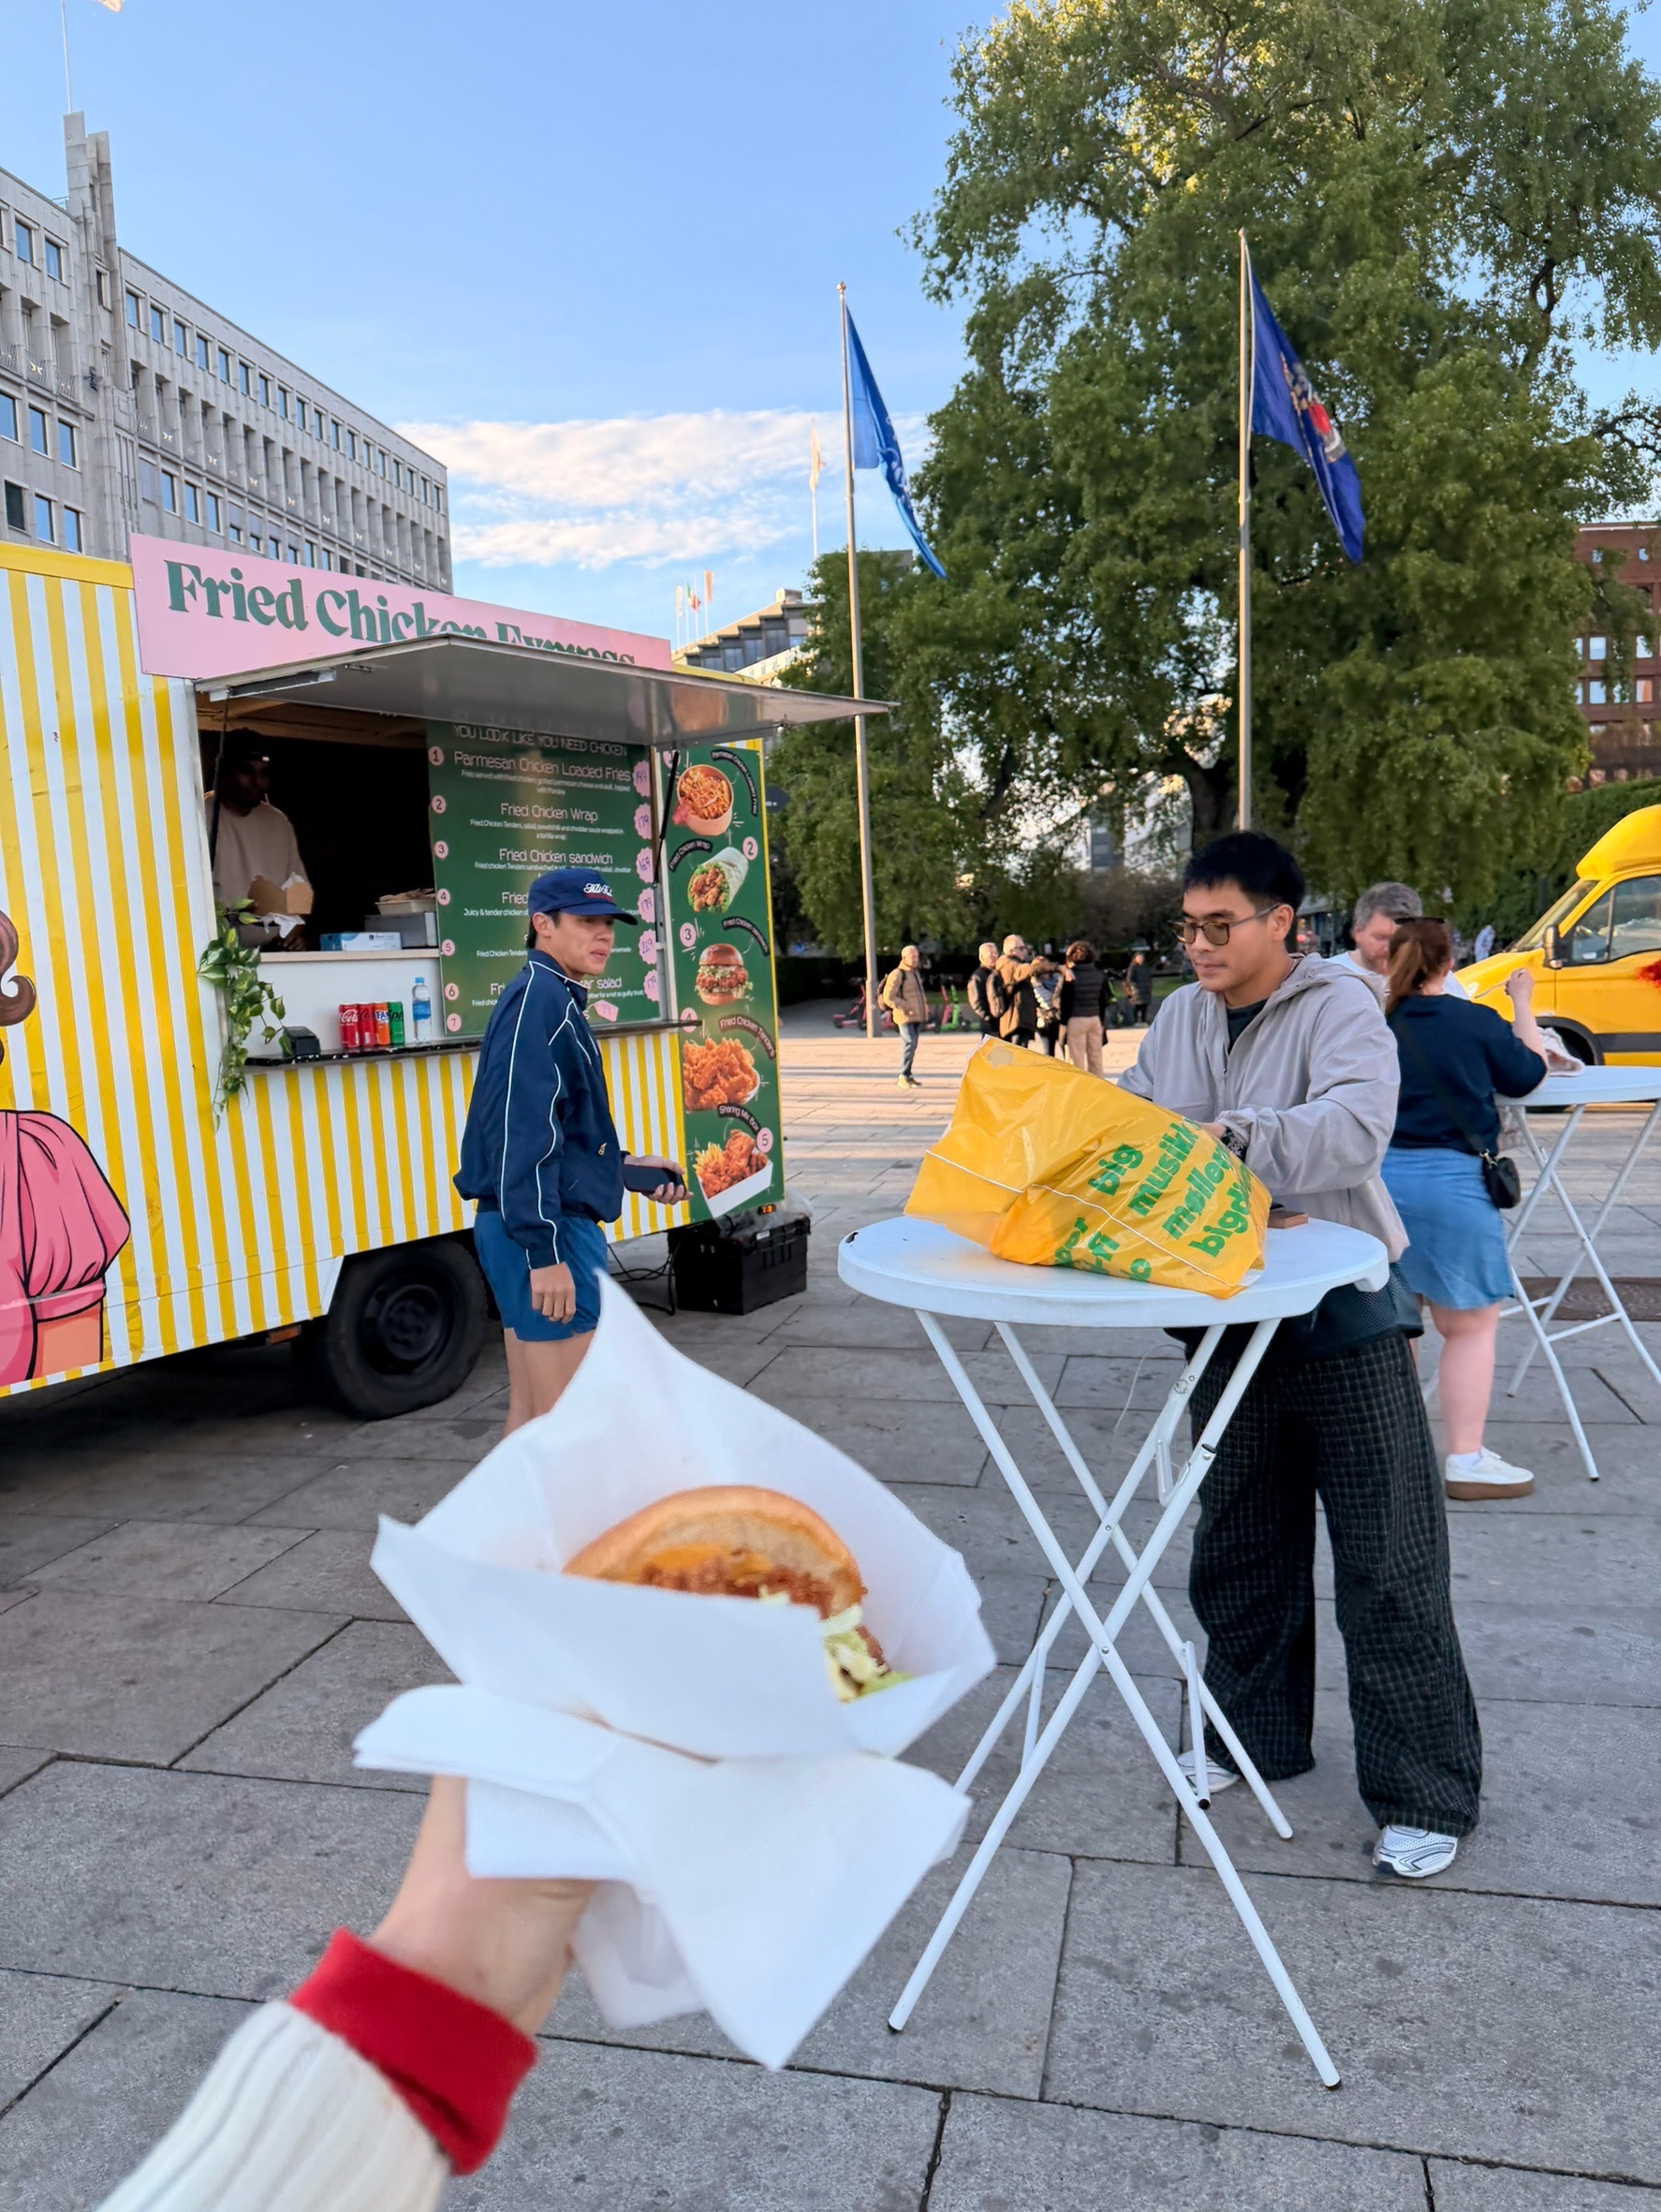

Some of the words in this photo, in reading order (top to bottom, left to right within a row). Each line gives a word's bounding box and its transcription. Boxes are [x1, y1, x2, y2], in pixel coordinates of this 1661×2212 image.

[166, 560, 309, 631] Fried
[453, 725, 477, 739] YOU
[479, 728, 509, 743] LOOK
[512, 731, 535, 745] LIKE
[537, 735, 559, 749] YOU
[561, 737, 588, 752] NEED
[454, 751, 516, 770] Parmesan
[519, 757, 559, 774] Chicken
[561, 762, 604, 779] Loaded
[605, 766, 631, 782] Fries
[501, 803, 529, 817] Fried
[531, 804, 568, 819] Chicken
[570, 807, 598, 824] Wrap
[499, 848, 527, 862] Fried
[530, 849, 566, 863] Chicken
[568, 851, 613, 864] sandwich
[747, 841, 755, 856] 2
[501, 892, 529, 905] Fried
[684, 928, 692, 941] 3
[596, 977, 622, 989] salad
[720, 1017, 736, 1029] Fried
[737, 1016, 758, 1032] Chicken
[757, 1027, 775, 1057] Tenders
[719, 1105, 741, 1117] Sharing
[741, 1109, 750, 1121] Mix
[749, 1116, 759, 1132] Box
[761, 1133, 769, 1147] 5
[1087, 1143, 1143, 1197] big
